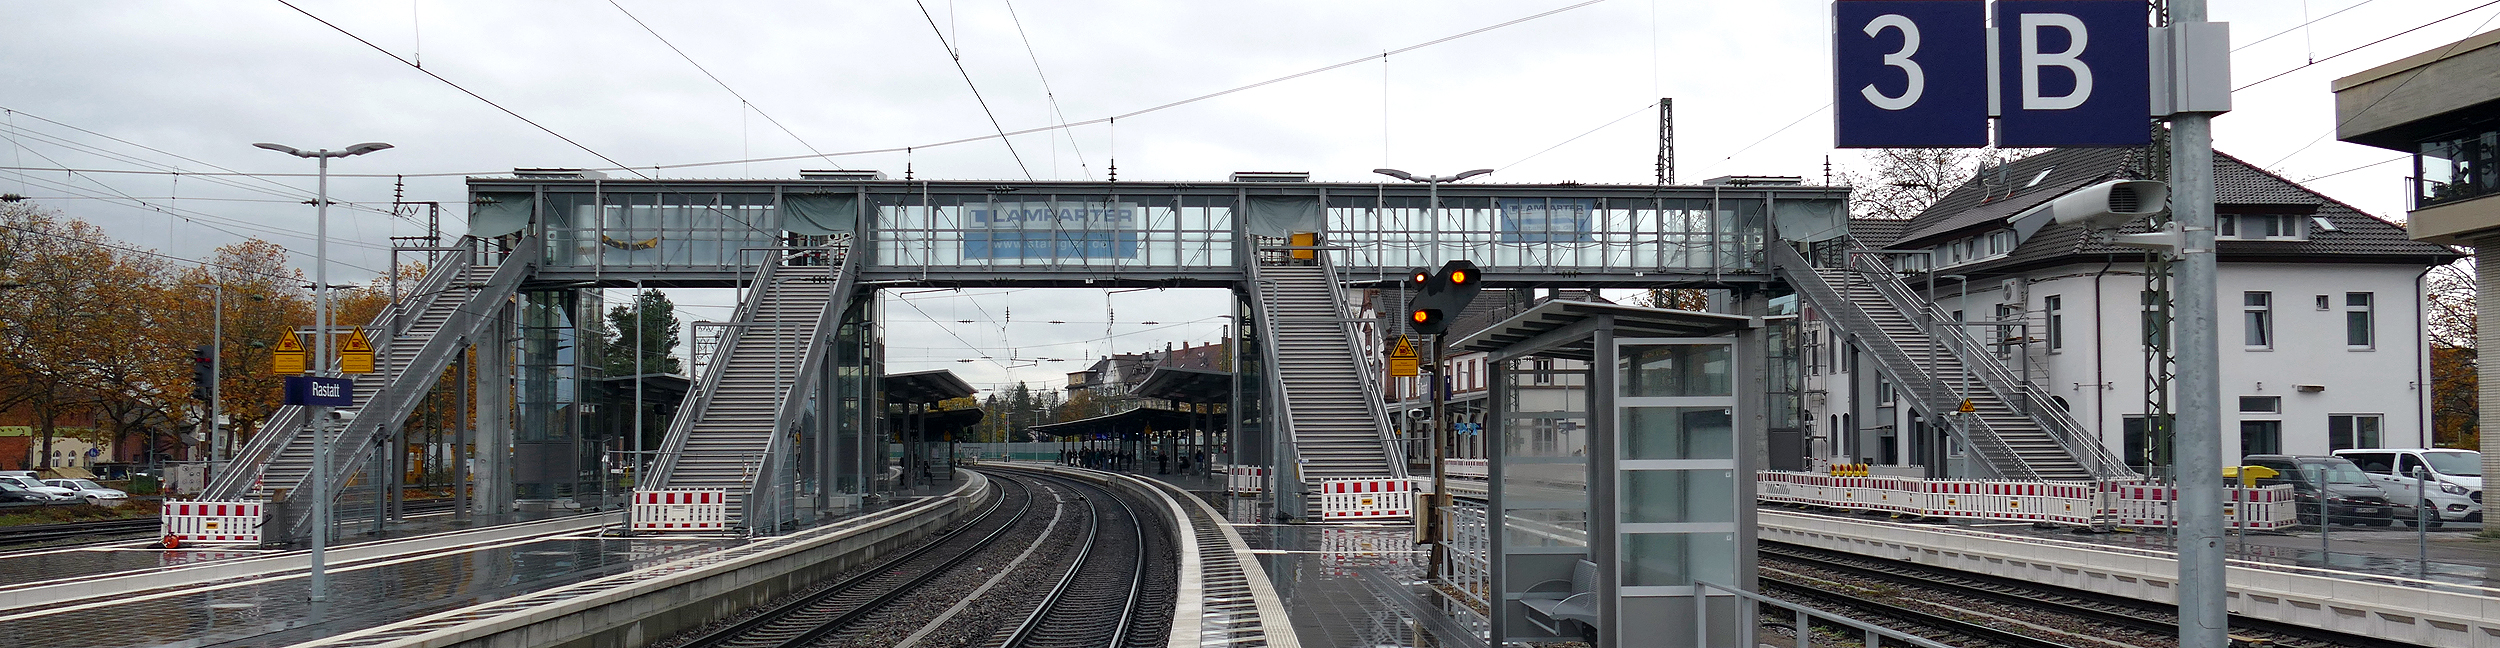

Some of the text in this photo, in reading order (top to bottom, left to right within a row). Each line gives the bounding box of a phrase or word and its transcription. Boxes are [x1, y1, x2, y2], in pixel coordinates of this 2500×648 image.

[1861, 13, 1925, 111] 3
[2020, 13, 2093, 110] B
[1519, 204, 1584, 212] LAMARTER
[312, 381, 340, 398] Rastatt
